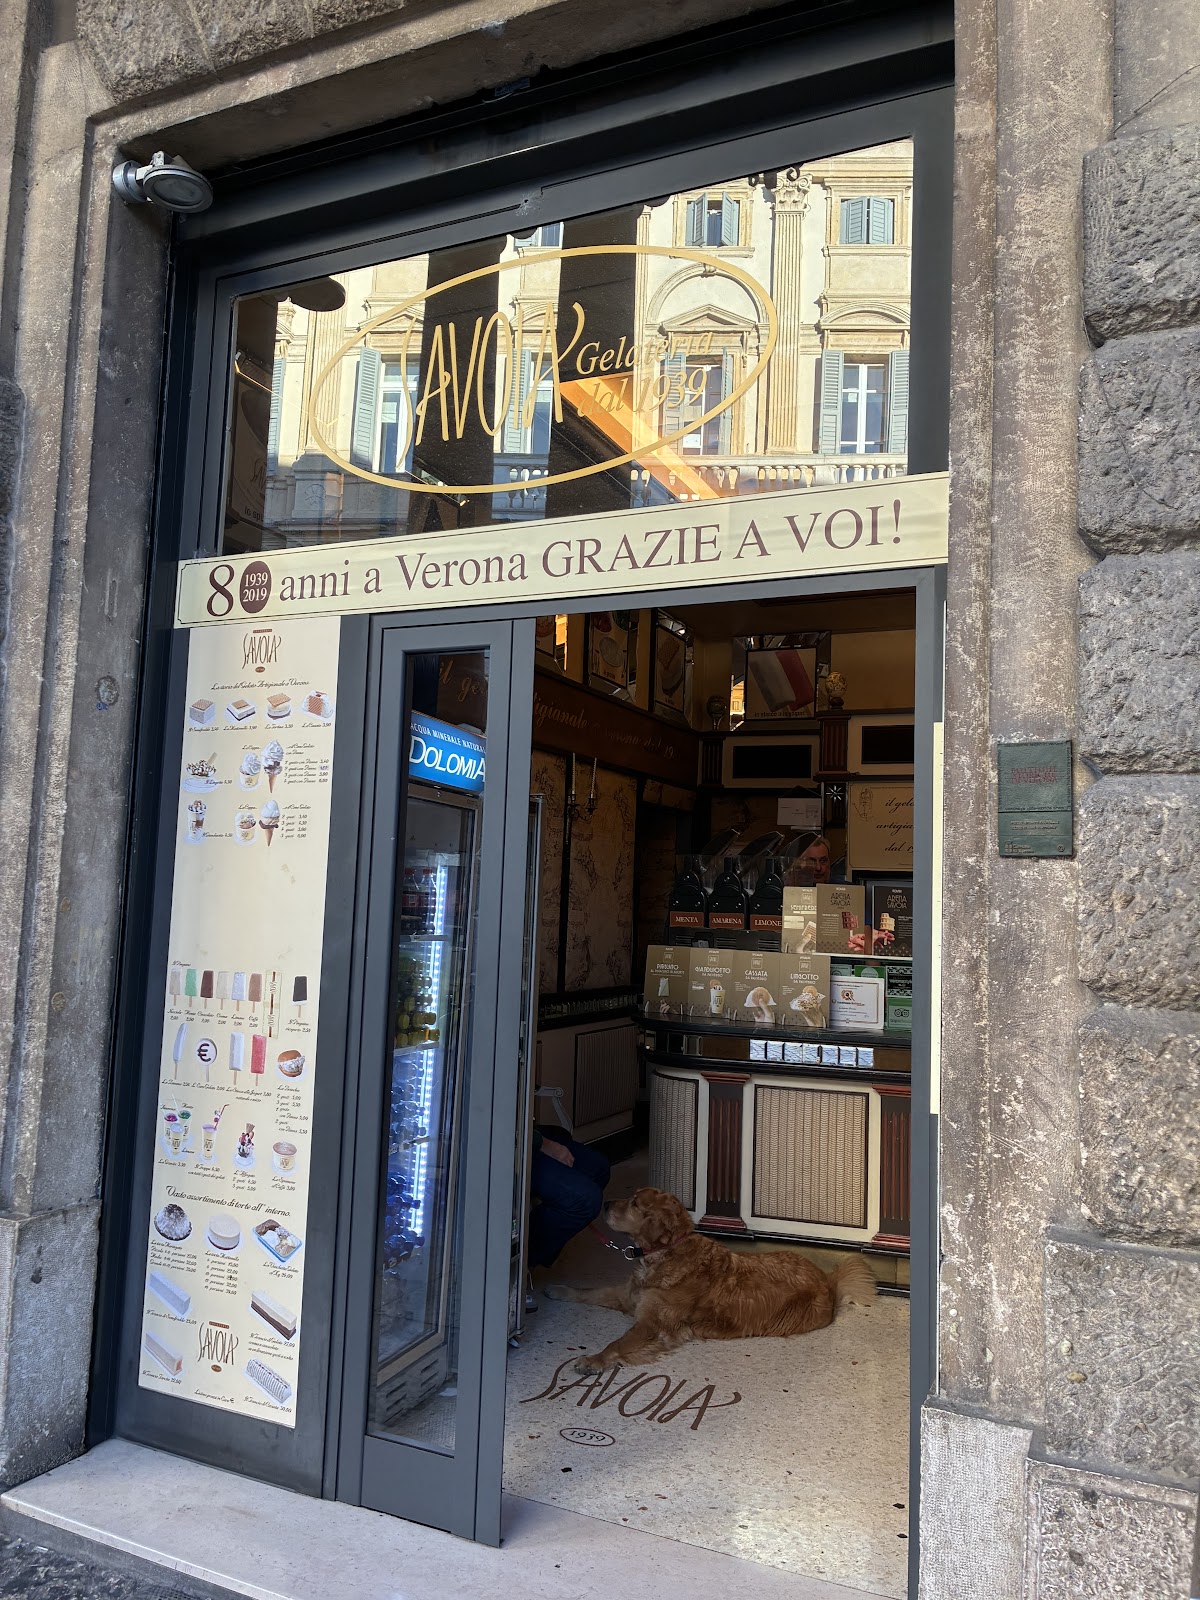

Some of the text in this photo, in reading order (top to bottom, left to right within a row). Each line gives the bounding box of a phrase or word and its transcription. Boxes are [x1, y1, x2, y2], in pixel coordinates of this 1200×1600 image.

[576, 332, 713, 375] Gelateria
[395, 302, 585, 470] SAVOIA
[577, 368, 708, 418] dal 1939
[279, 559, 351, 602] anni
[364, 567, 383, 594] a
[395, 552, 529, 591] Verona
[542, 524, 722, 578] GRAZIE
[733, 519, 771, 560] A
[783, 499, 901, 553] VOI!
[242, 587, 268, 602] 2019
[245, 572, 268, 587] 1939
[241, 633, 282, 670] SAVOIA
[410, 722, 432, 736] ACQUA
[432, 729, 462, 747] MINERALE
[711, 917, 742, 925] AMARENA
[754, 919, 783, 927] LIMONE
[166, 1185, 187, 1198] Vasto
[187, 1195, 227, 1206] assortimento
[227, 1198, 235, 1207] di
[197, 1322, 239, 1366] SAVOIA
[519, 1353, 743, 1431] SAVOIA
[568, 1429, 607, 1443] 1939
